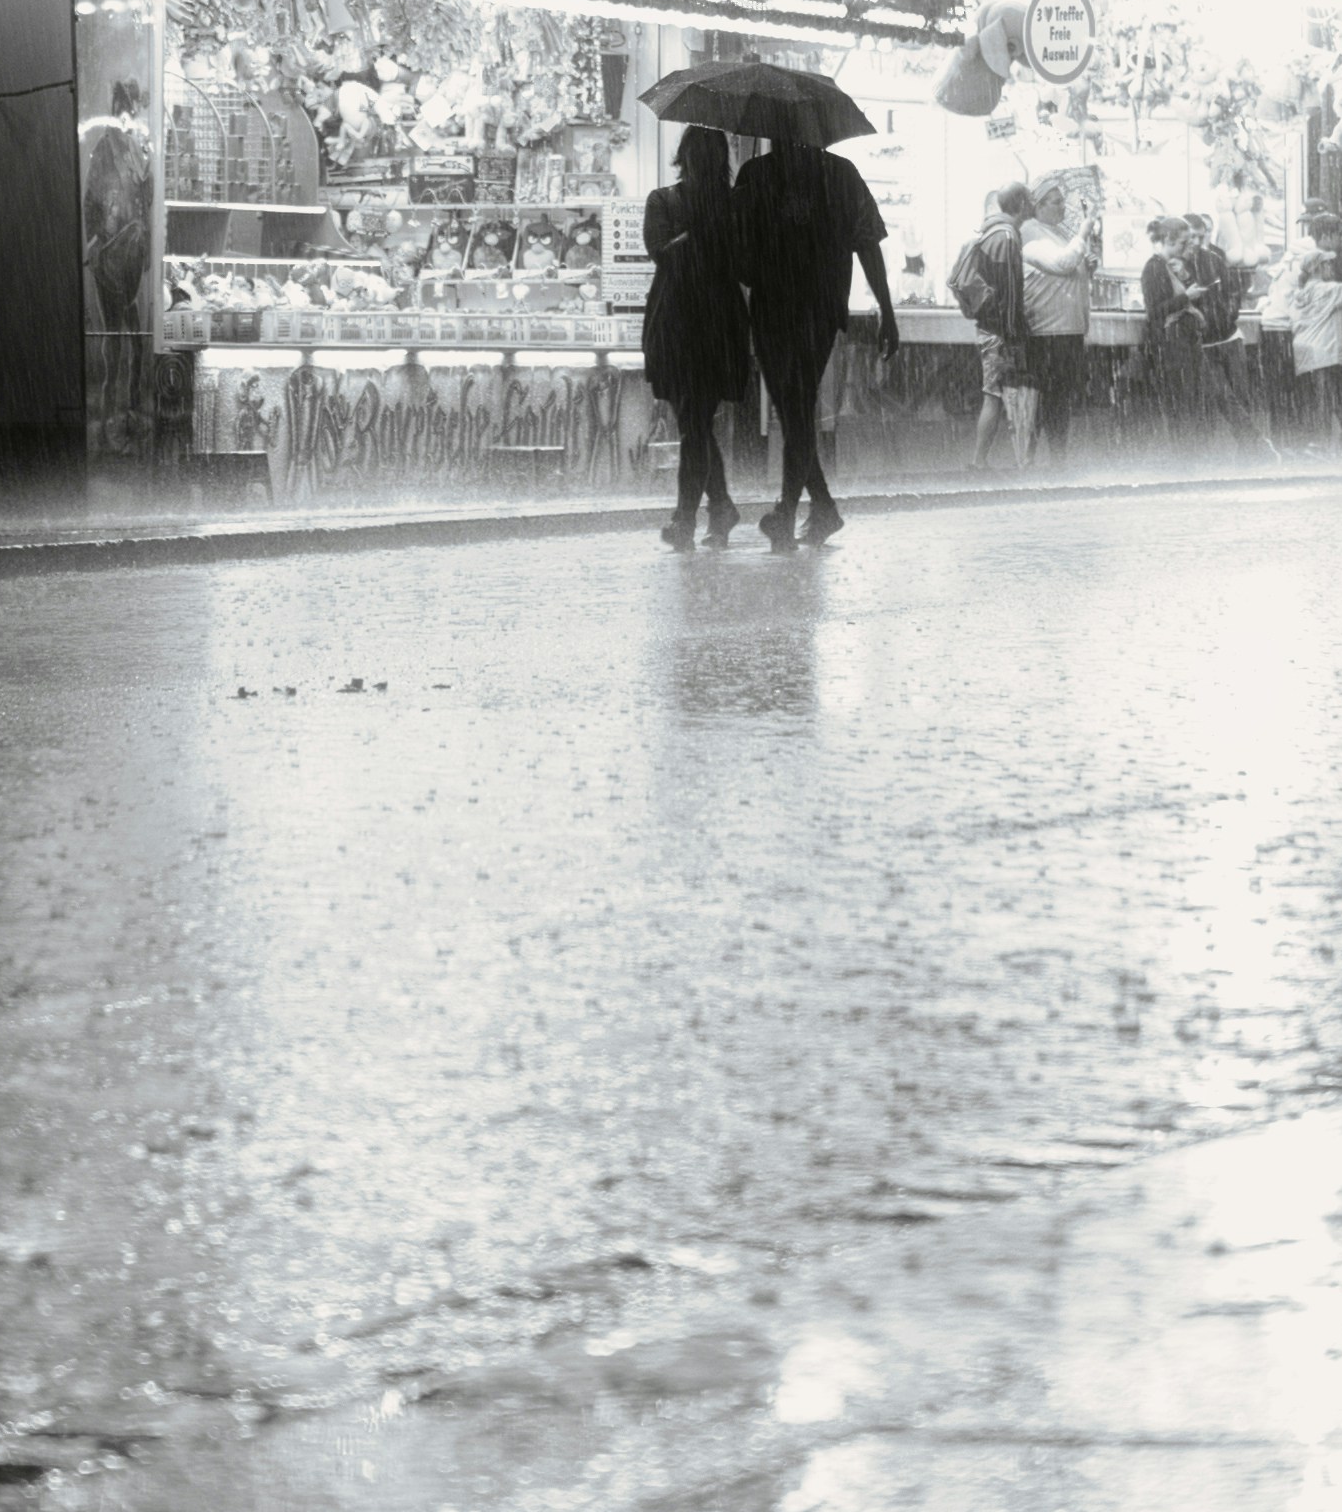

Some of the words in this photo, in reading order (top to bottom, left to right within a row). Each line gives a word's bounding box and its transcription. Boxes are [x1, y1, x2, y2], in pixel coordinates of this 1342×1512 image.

[1037, 8, 1043, 23] 3
[1054, 5, 1084, 22] Treffer
[1049, 26, 1071, 41] Freie
[1042, 44, 1079, 62] Auswahl
